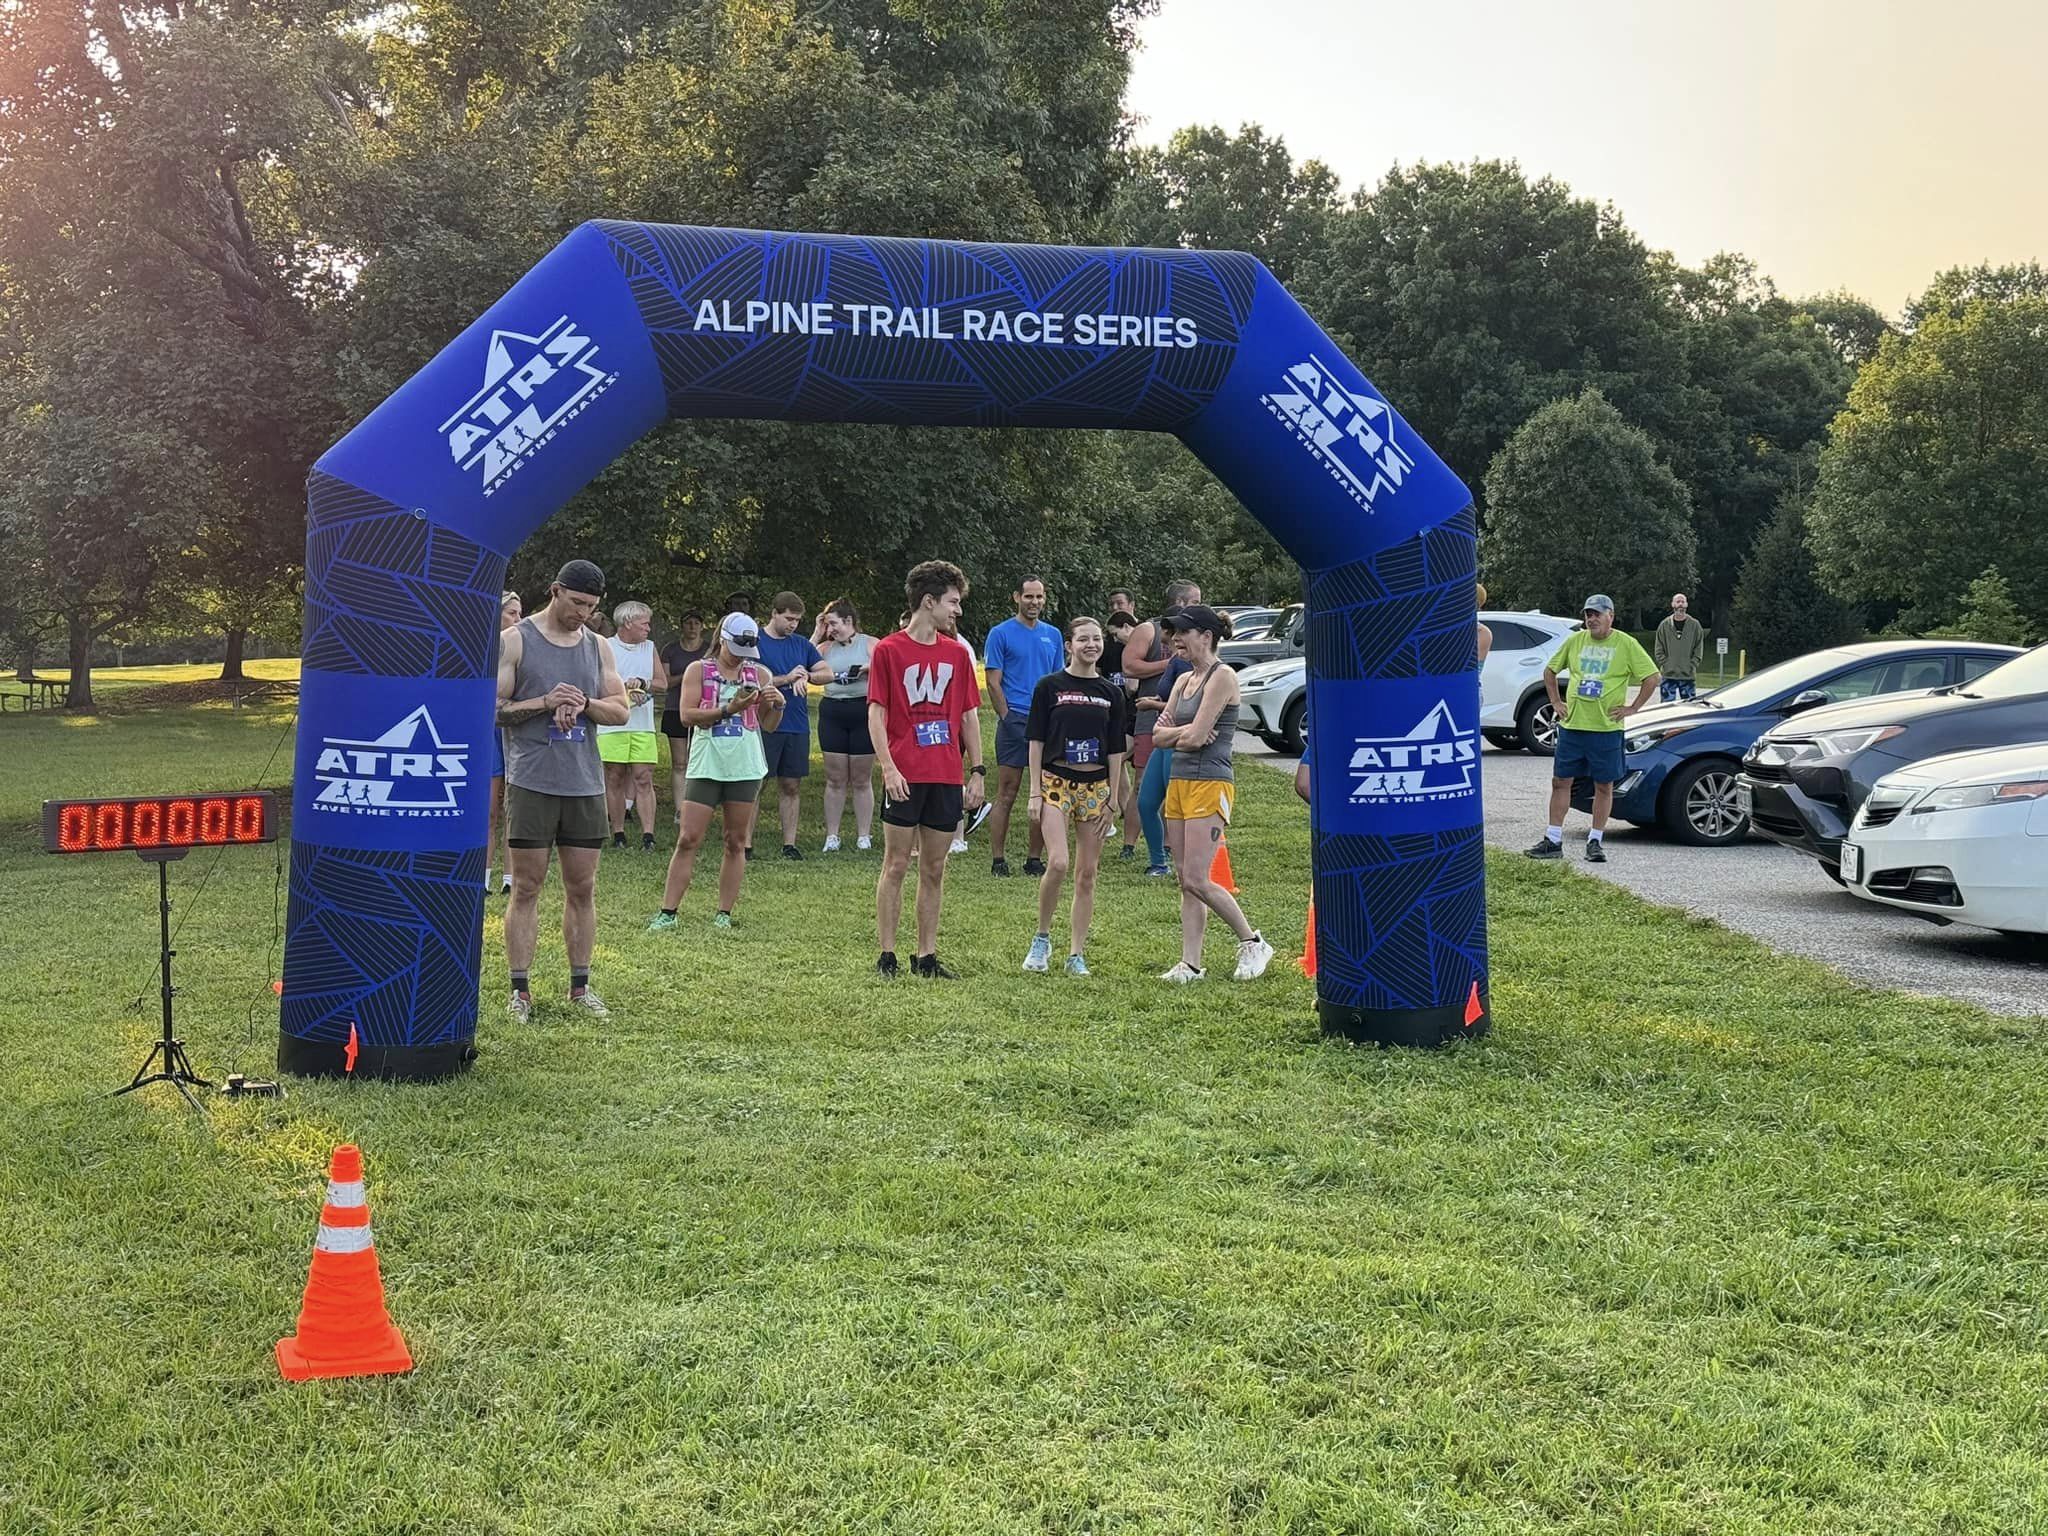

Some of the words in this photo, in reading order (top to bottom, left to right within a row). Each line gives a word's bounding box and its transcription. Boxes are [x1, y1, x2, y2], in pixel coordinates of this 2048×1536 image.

[693, 299, 834, 335] ALPINE
[843, 304, 954, 340] TRAIL
[963, 309, 1065, 344] RACE
[1073, 313, 1199, 349] SERIES
[449, 322, 591, 465] ATRS
[1258, 394, 1296, 432] SAVE
[1296, 431, 1323, 461] THE
[1287, 362, 1411, 487] ATRS
[483, 459, 525, 498] SAVE
[525, 428, 557, 458] THE
[903, 662, 954, 707] W
[929, 733, 942, 745] 16
[1077, 752, 1089, 763] 15
[1348, 738, 1475, 768] ATRS
[315, 748, 469, 777] ATRS
[312, 802, 351, 815] SAVE
[354, 807, 391, 817] THE
[1348, 796, 1389, 804] SAVE
[1392, 795, 1425, 804] THE
